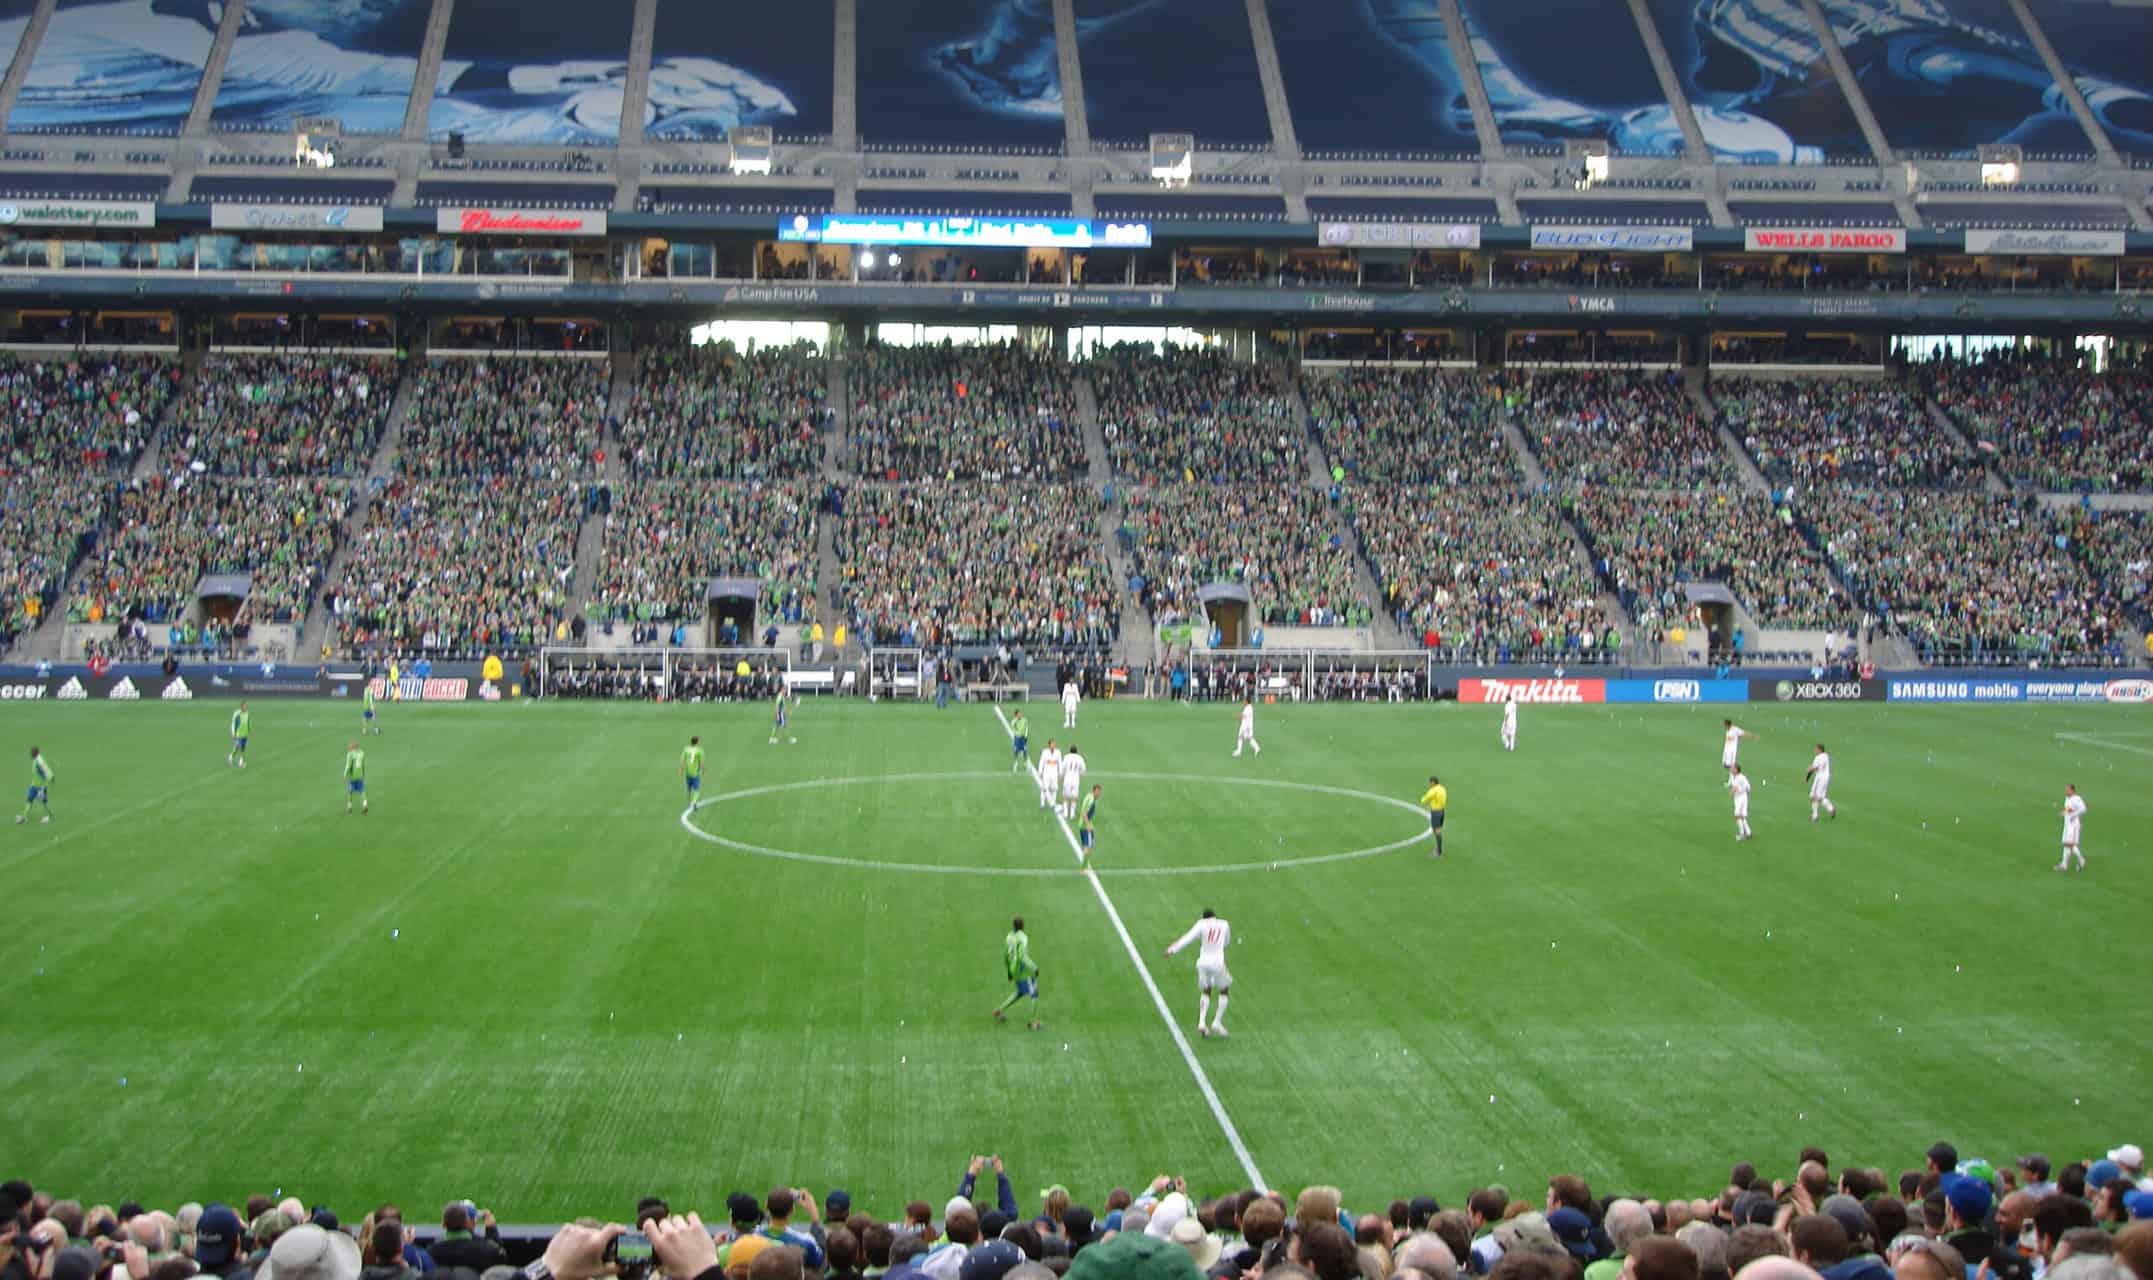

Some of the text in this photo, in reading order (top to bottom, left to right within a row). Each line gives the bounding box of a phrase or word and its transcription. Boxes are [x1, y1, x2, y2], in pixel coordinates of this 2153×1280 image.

[23, 206, 139, 224] walottery.com
[461, 208, 582, 232] Budweiser
[1755, 232, 1895, 247] WELLS FARGO
[1580, 296, 1615, 312] YMCA
[0, 684, 47, 699] ccer
[1481, 679, 1583, 703] Makita
[1795, 682, 1861, 699] XBOX 360
[1892, 682, 1967, 698] SAMSUNG
[1208, 927, 1222, 944] 10
